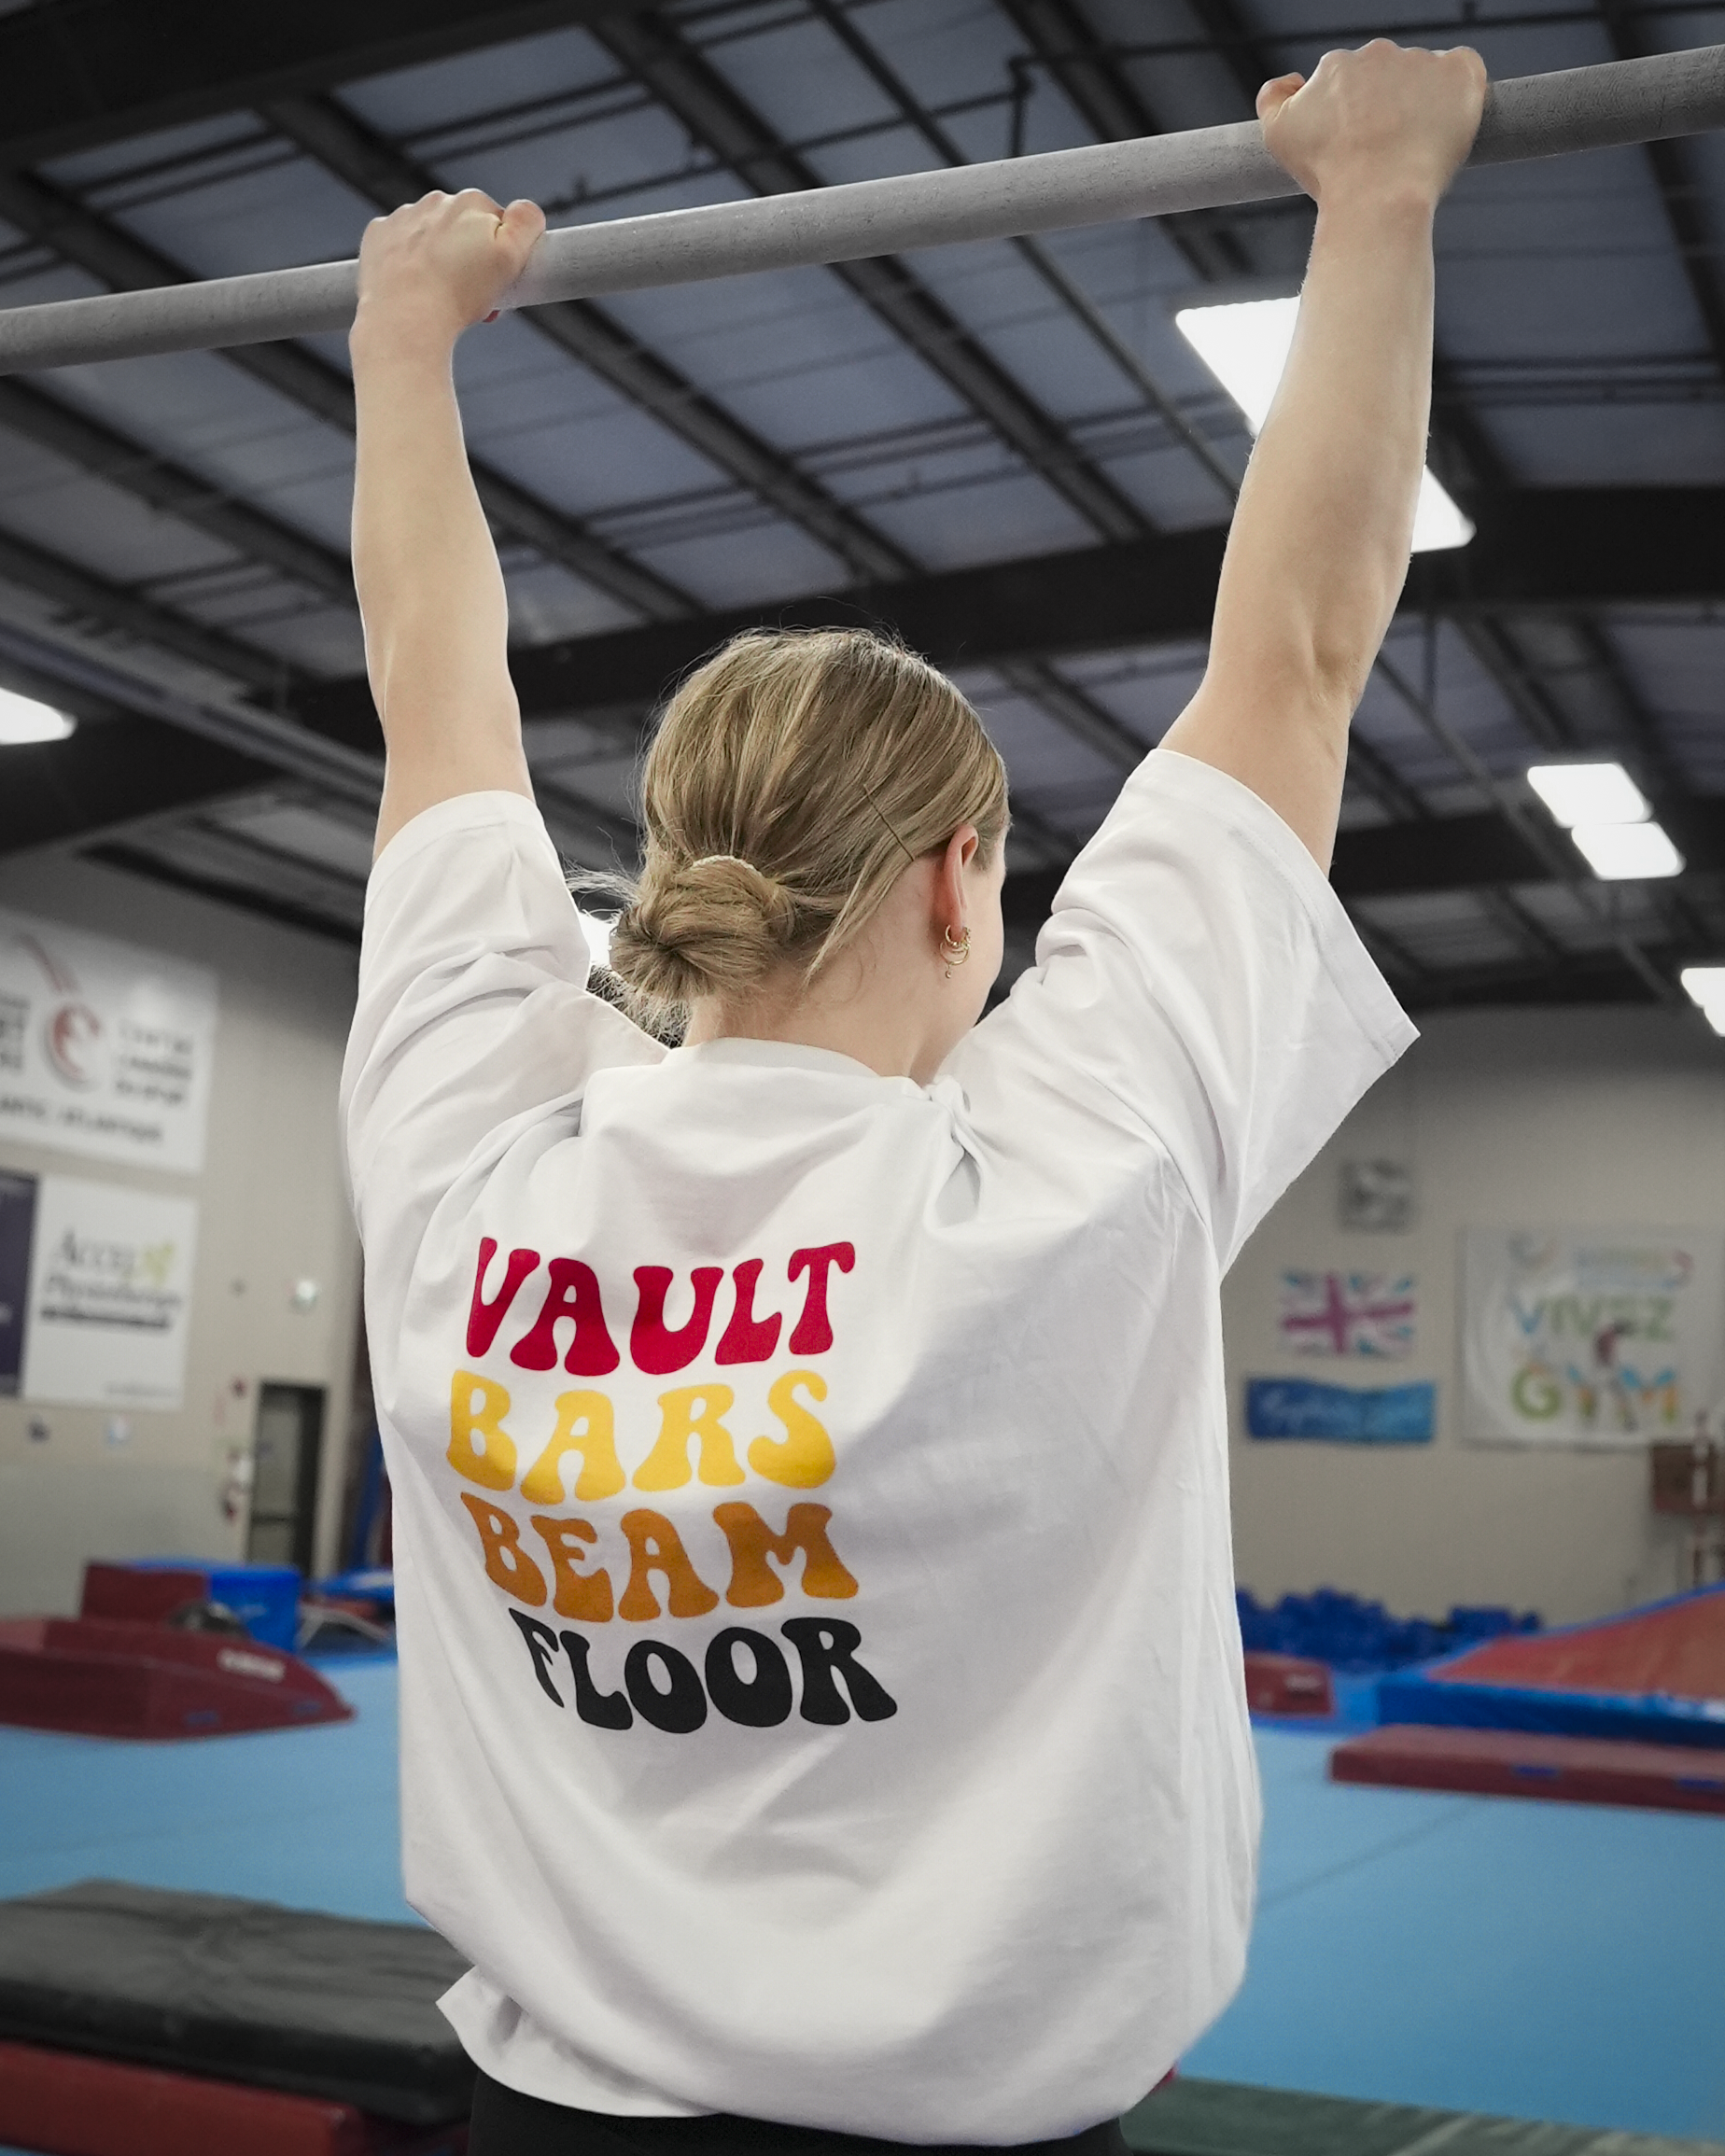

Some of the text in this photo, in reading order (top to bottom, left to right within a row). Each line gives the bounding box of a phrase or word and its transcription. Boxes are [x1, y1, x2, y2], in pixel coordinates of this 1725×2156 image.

[467, 1238, 855, 1377] VAULT
[446, 1370, 836, 1505] BARS
[461, 1492, 858, 1623] BEAM
[509, 1607, 897, 1733] FLOOR
